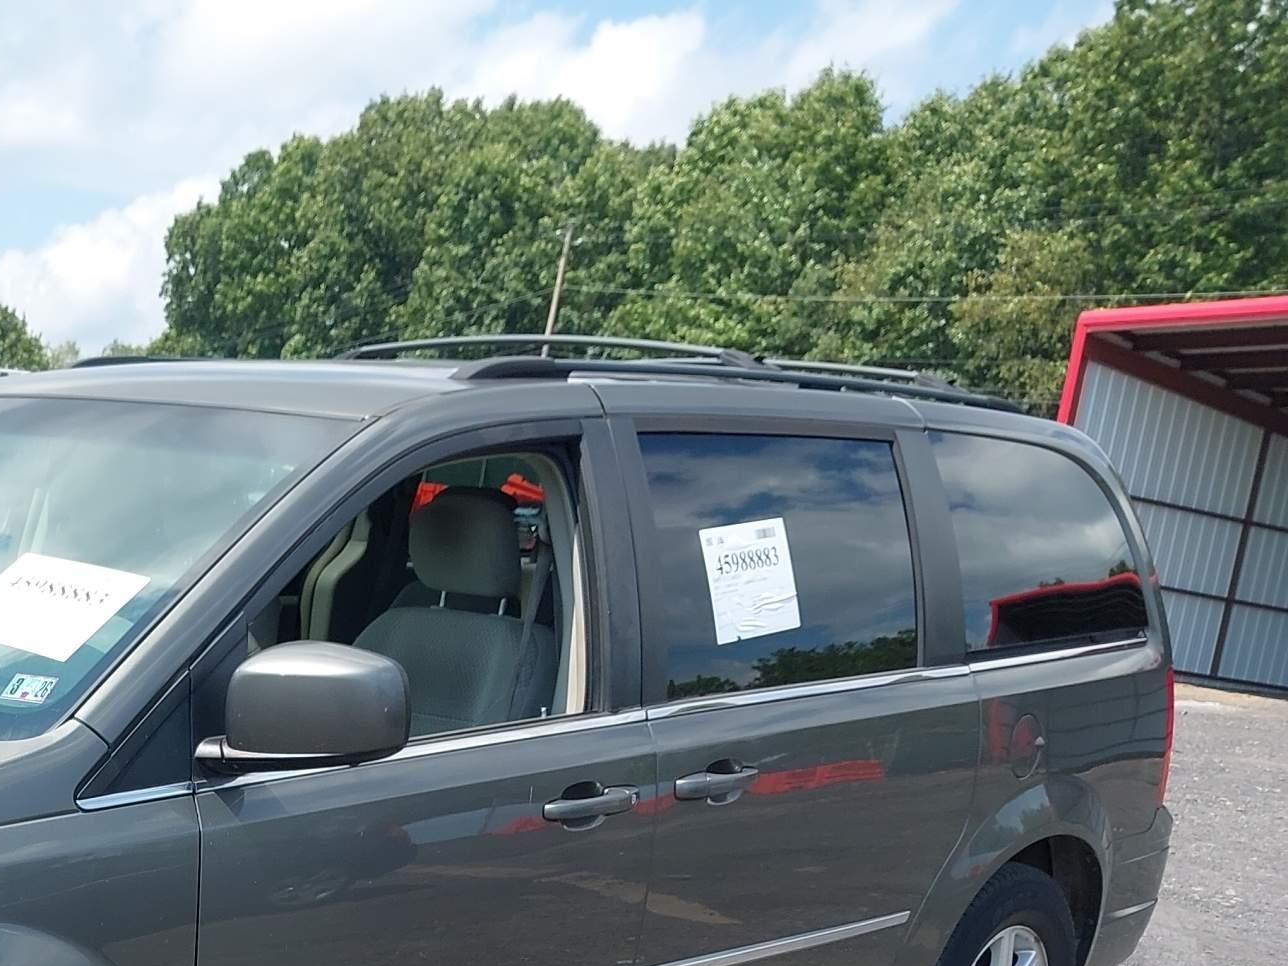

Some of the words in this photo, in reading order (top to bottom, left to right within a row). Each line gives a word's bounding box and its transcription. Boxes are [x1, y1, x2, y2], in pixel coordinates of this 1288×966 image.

[716, 546, 780, 575] 45988883
[10, 678, 25, 695] 3
[34, 680, 53, 698] 26
